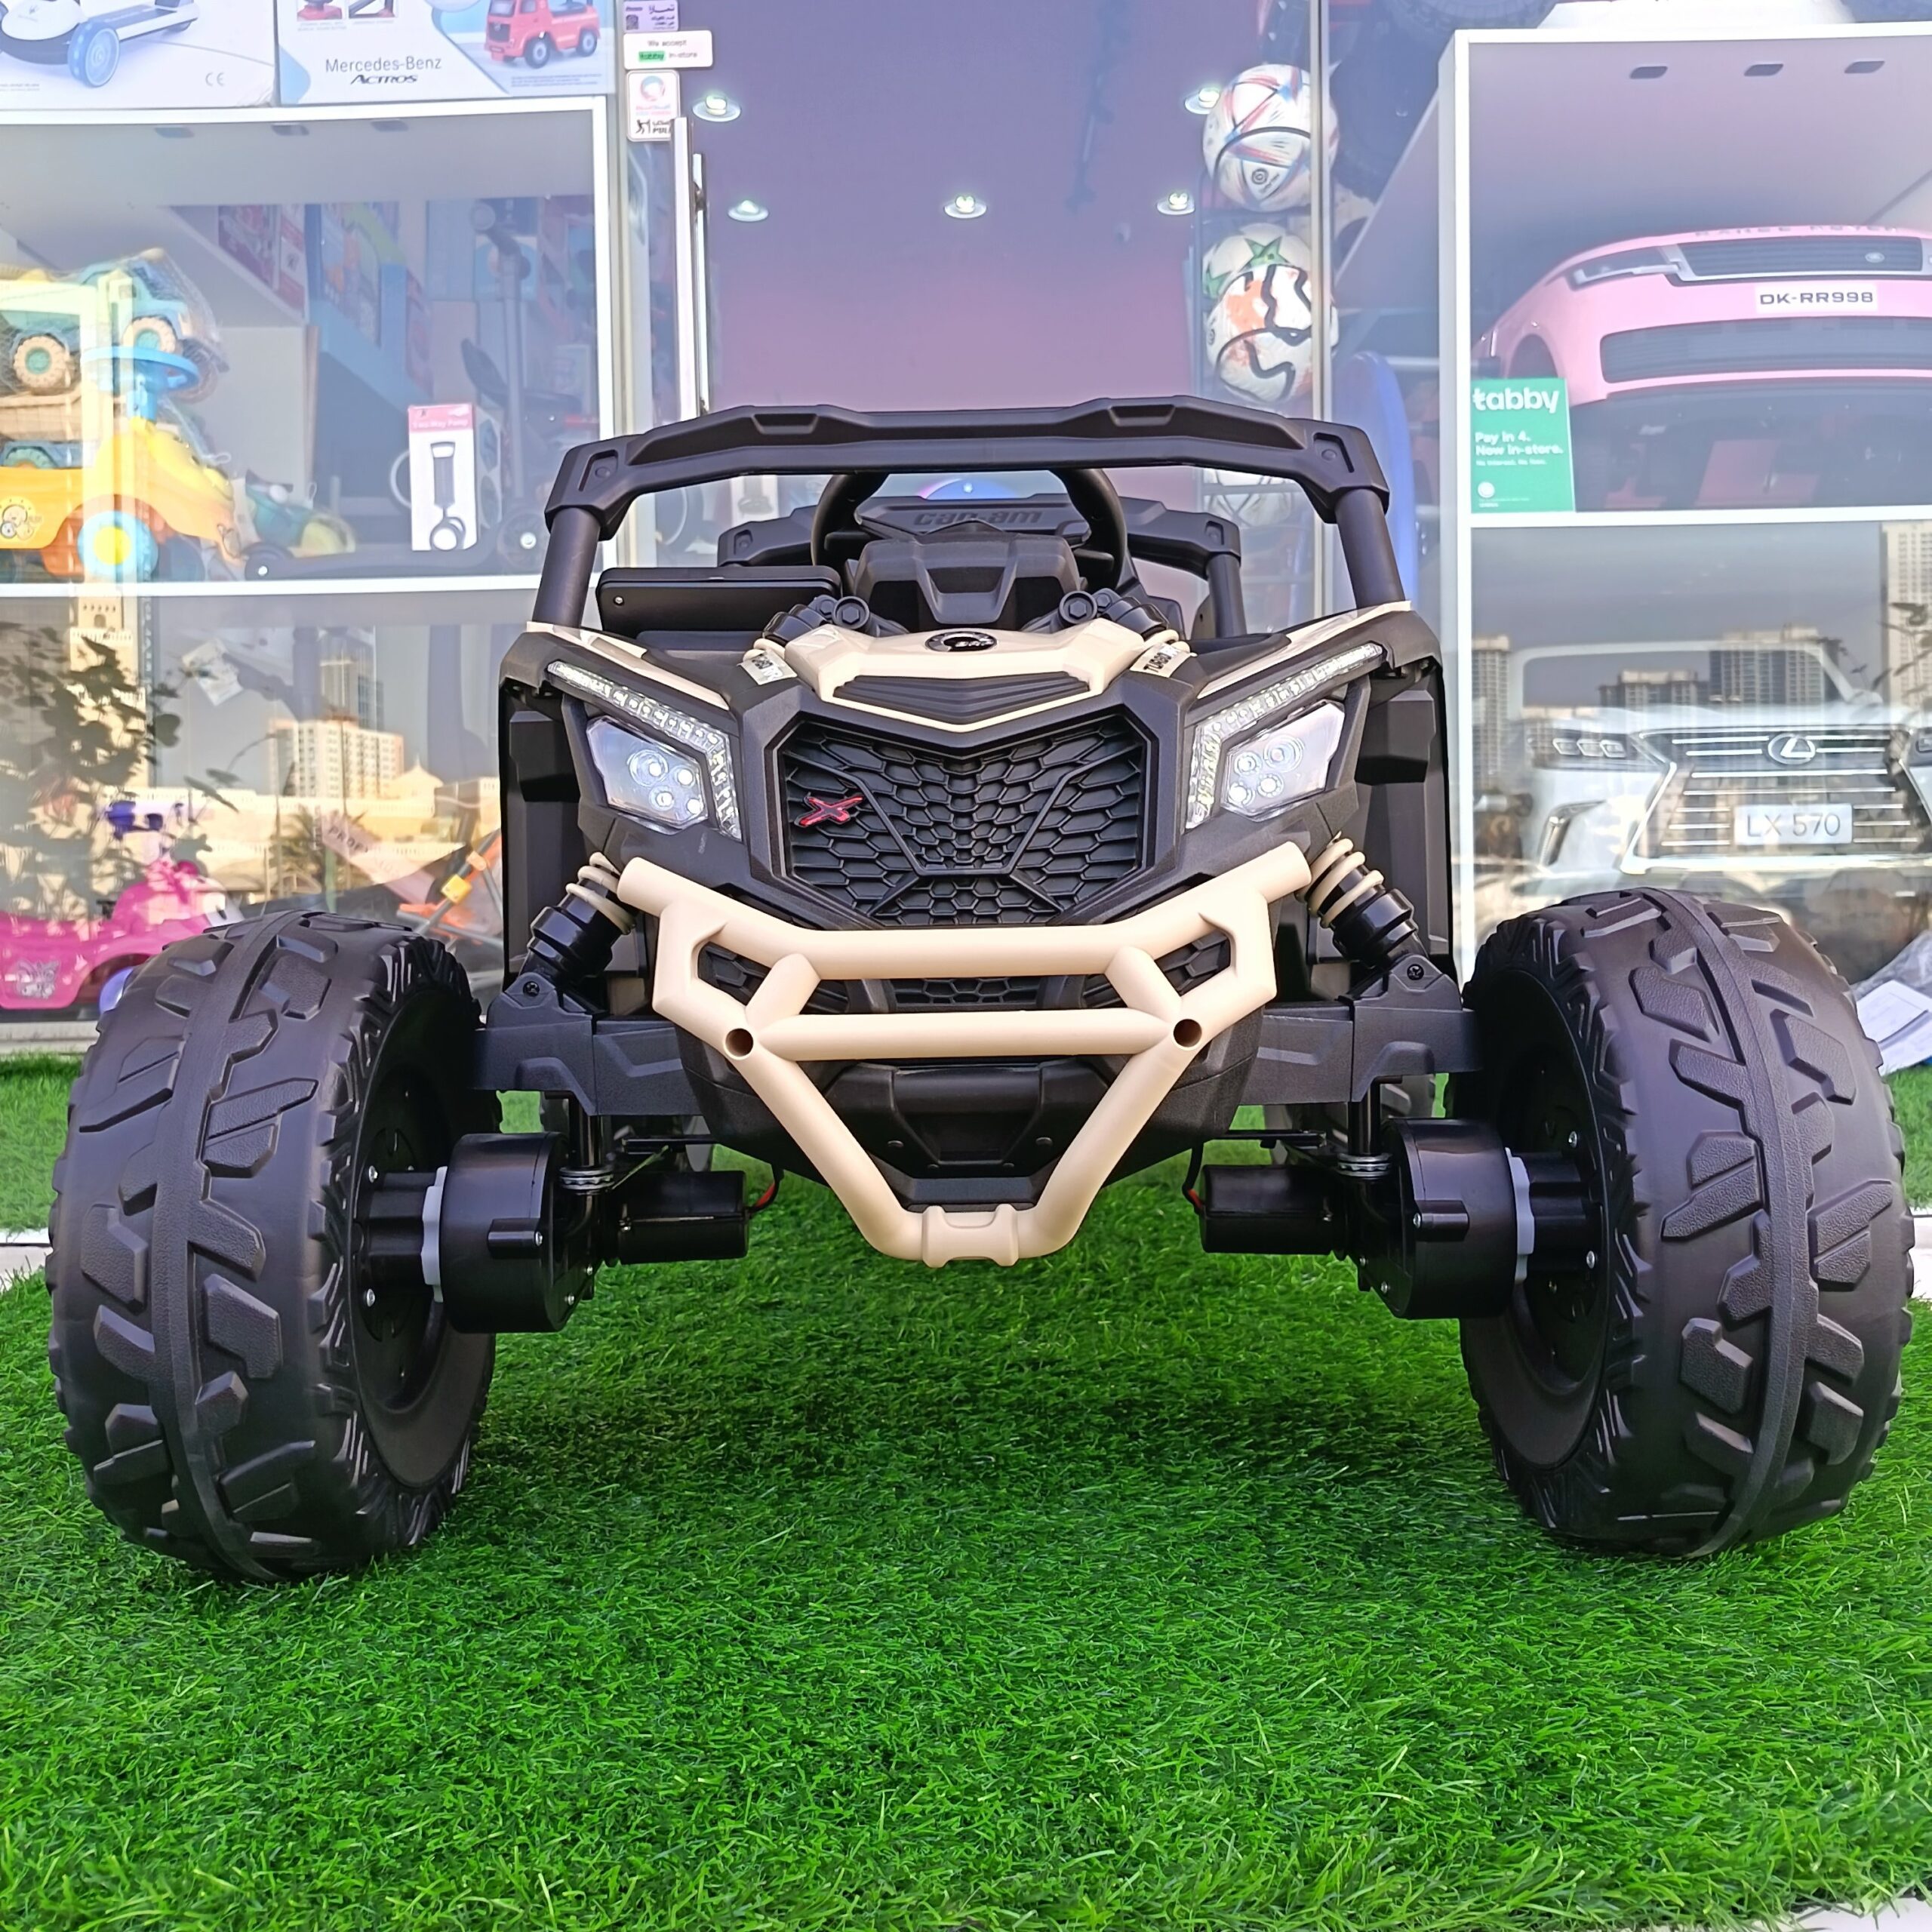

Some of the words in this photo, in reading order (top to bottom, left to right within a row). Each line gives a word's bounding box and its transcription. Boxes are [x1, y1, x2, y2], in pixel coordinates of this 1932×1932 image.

[325, 56, 442, 73] Mercedes-Benz
[1759, 291, 1875, 306] DK-RR998
[1472, 386, 1560, 414] tabby
[1475, 432, 1499, 445] Pay
[1502, 431, 1515, 442] in
[1475, 445, 1504, 456] Now
[1747, 814, 1782, 837] LX
[1792, 813, 1841, 837] 570
